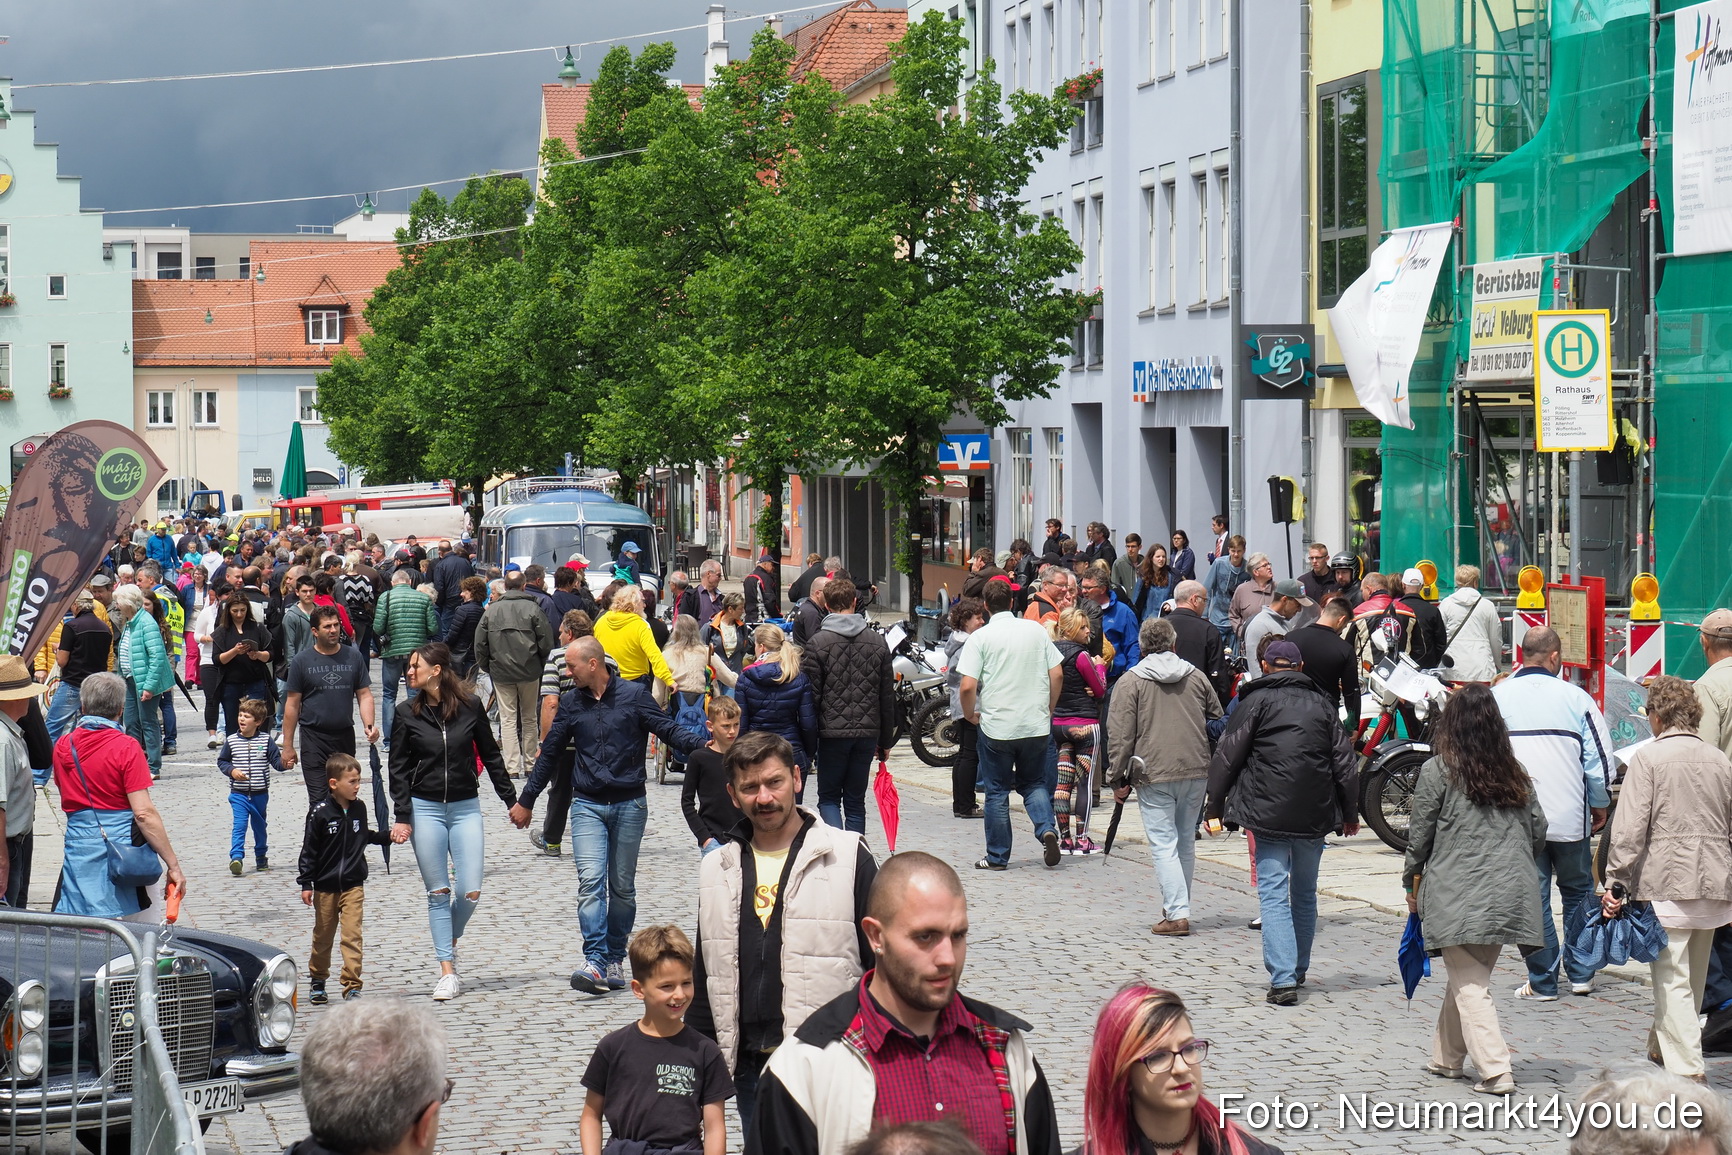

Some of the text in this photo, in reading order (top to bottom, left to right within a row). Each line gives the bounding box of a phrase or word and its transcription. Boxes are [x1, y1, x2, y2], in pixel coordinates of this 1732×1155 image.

[1476, 269, 1540, 295] Gerüstbau
[1501, 309, 1533, 340] Velburg
[1268, 345, 1293, 376] G2
[1561, 333, 1583, 366] H
[1149, 355, 1213, 392] Raiffeisenbank
[1470, 355, 1479, 371] Tel.
[1555, 386, 1592, 394] Rathaus
[102, 458, 131, 475] más
[113, 466, 142, 491] café
[1, 555, 28, 651] GRANO
[308, 664, 353, 675] FALLS CREEK
[328, 826, 338, 835] 12
[656, 1063, 696, 1081] OLD SCHOOL
[204, 1083, 238, 1111] 272H
